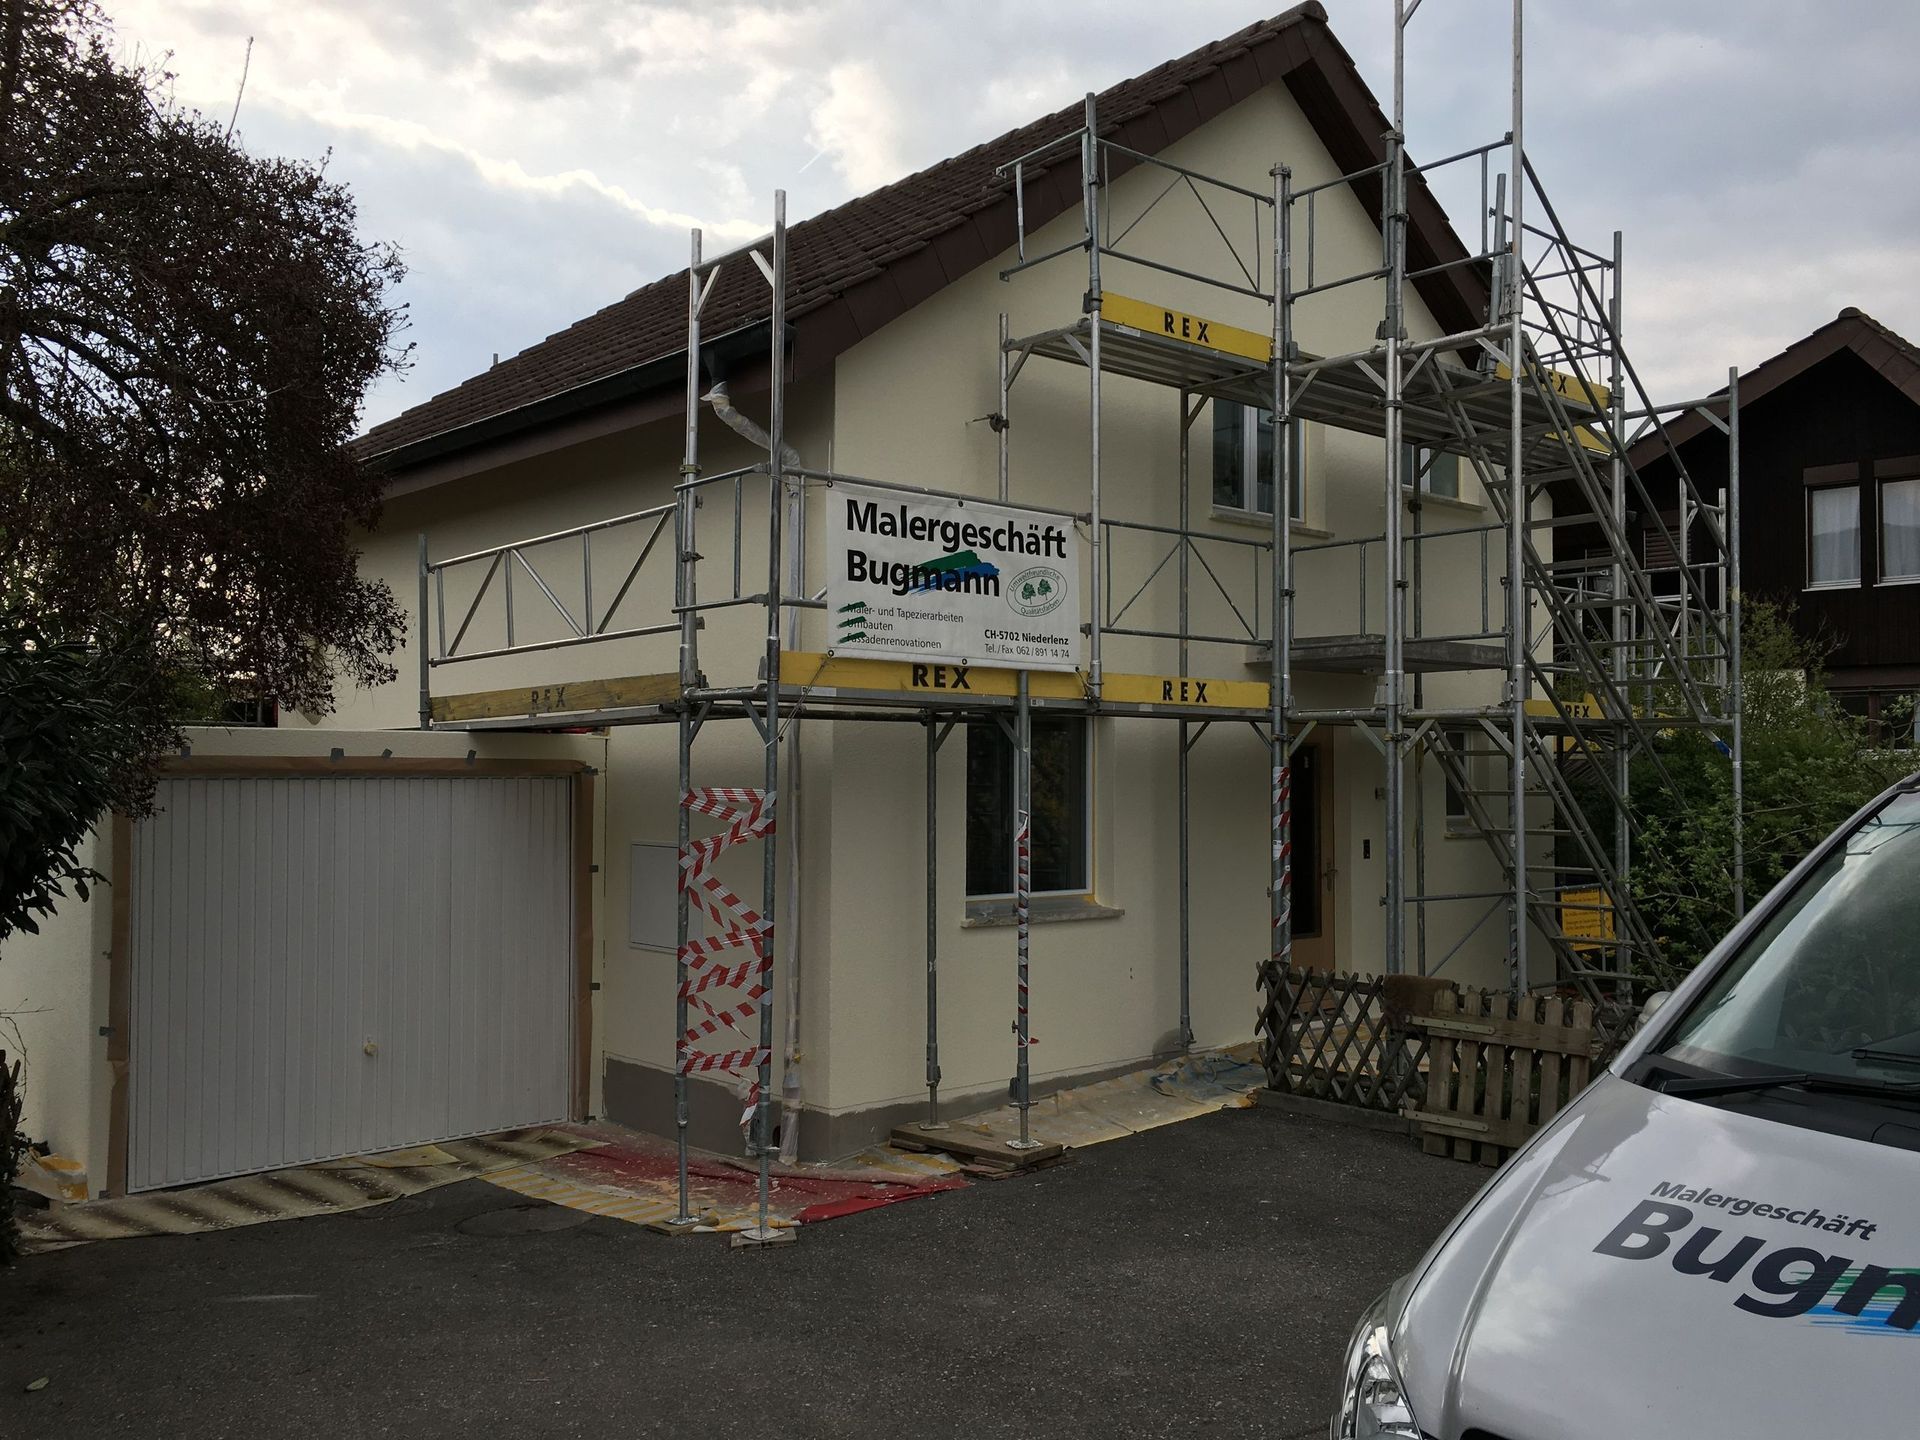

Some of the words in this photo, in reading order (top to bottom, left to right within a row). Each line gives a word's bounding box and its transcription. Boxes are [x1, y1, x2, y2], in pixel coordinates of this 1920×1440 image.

[1164, 311, 1210, 344] REX
[846, 499, 1067, 559] Malergeschäft
[846, 549, 1000, 597] Bugmann
[878, 607, 894, 617] und
[896, 607, 964, 623] Tapezierarbeiten
[984, 629, 1020, 641] CH-5702
[1021, 632, 1069, 645] Niederlenz
[1050, 648, 1058, 658] 14
[1060, 649, 1070, 658] 74
[912, 663, 971, 690] REX
[1162, 680, 1208, 703] REX
[1650, 1181, 1878, 1242] Malergeschäft
